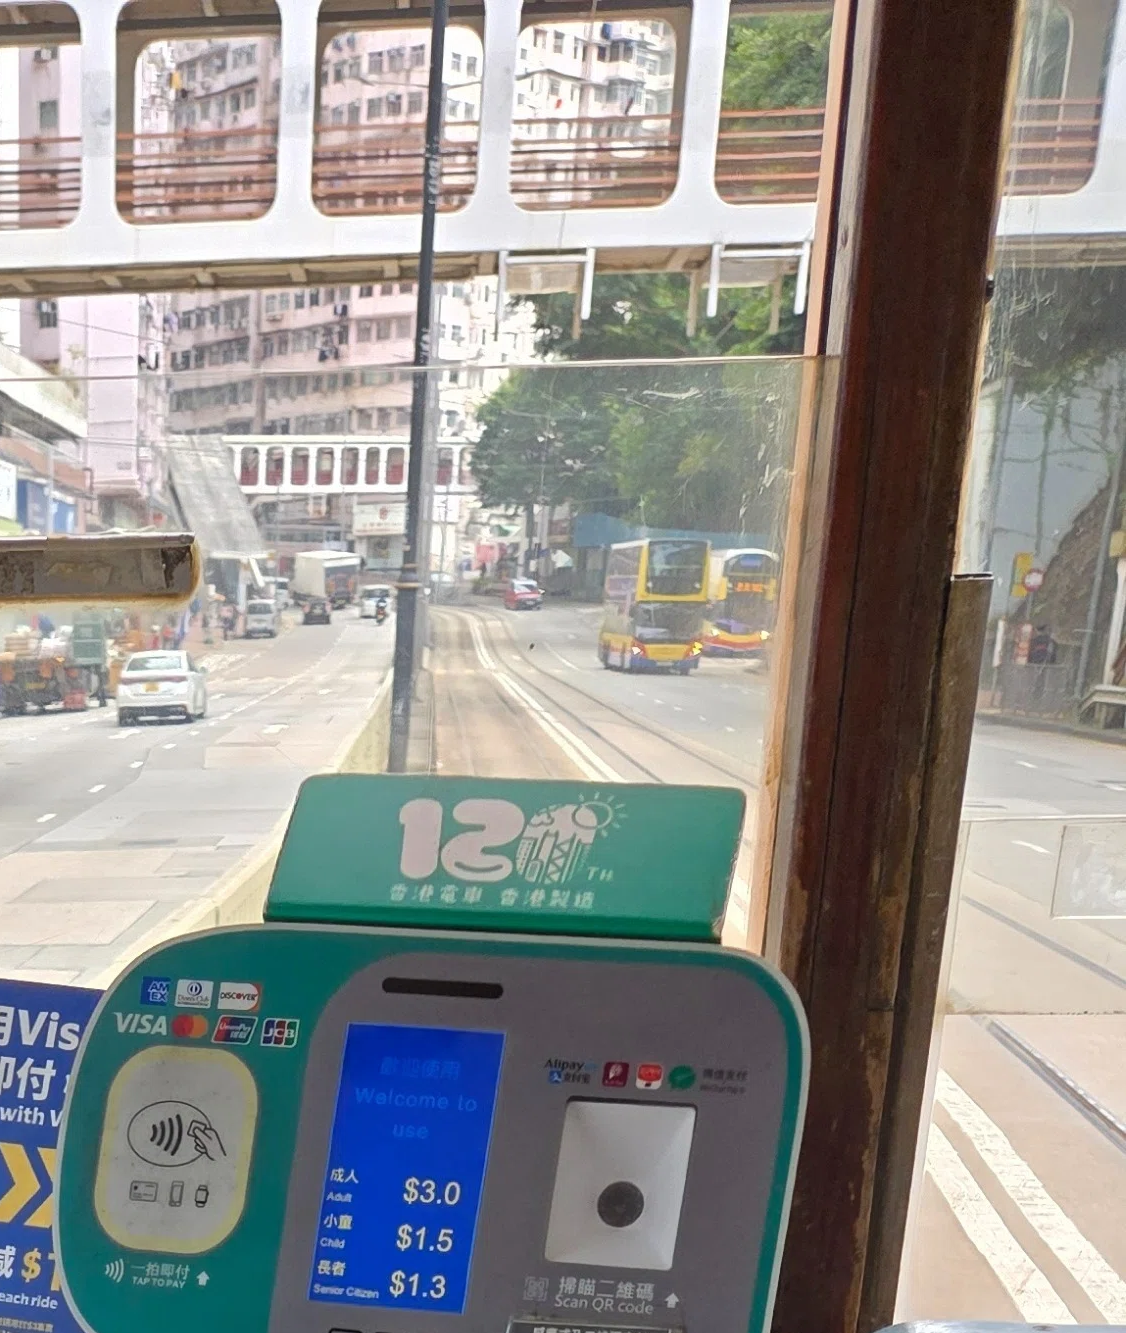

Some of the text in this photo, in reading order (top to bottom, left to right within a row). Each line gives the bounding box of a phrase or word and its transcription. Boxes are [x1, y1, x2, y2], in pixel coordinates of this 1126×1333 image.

[220, 991, 258, 1002] DISCOVER
[113, 1012, 167, 1036] VISA
[263, 1028, 295, 1039] JCB
[355, 1087, 478, 1112] Welcome to
[0, 1106, 45, 1126] with
[392, 1124, 430, 1139] use
[330, 1167, 359, 1184] 成人
[326, 1192, 353, 1203] Adult
[403, 1177, 461, 1205] $3.0
[324, 1213, 353, 1230] 小童
[320, 1237, 346, 1249] Child
[396, 1223, 454, 1252] $1.5
[130, 1261, 190, 1281] 一拍即付
[317, 1260, 346, 1276] 長者
[132, 1276, 186, 1289] TAP TO PAY
[389, 1270, 446, 1299] $1.3
[313, 1284, 379, 1299] Senior Citizen
[30, 1294, 58, 1310] ride
[554, 1294, 654, 1315] Scan QR code
